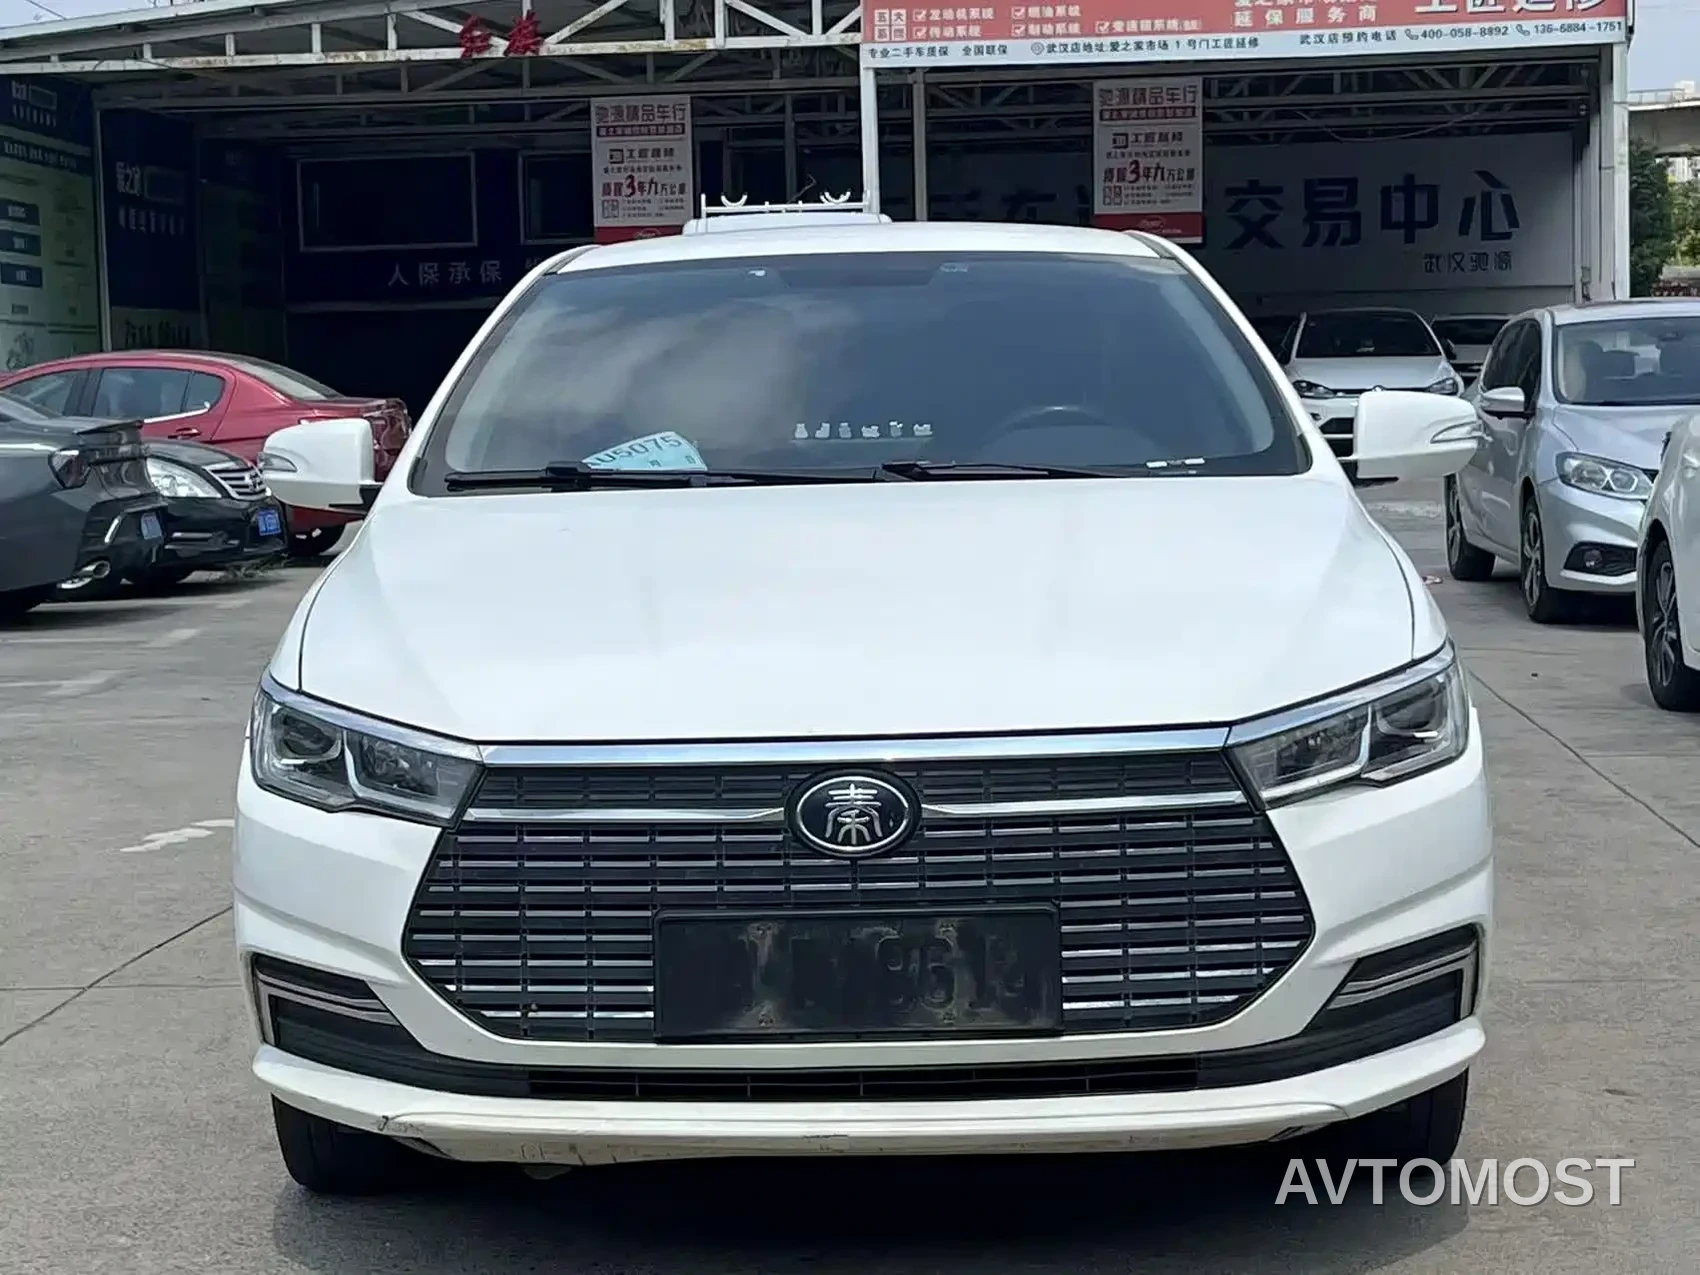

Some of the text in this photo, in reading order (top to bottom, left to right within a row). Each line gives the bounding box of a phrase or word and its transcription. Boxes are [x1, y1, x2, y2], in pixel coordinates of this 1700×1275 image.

[1223, 169, 1519, 249] 交易中心
[387, 260, 503, 286] 人保承保
[825, 783, 883, 845] 秦
